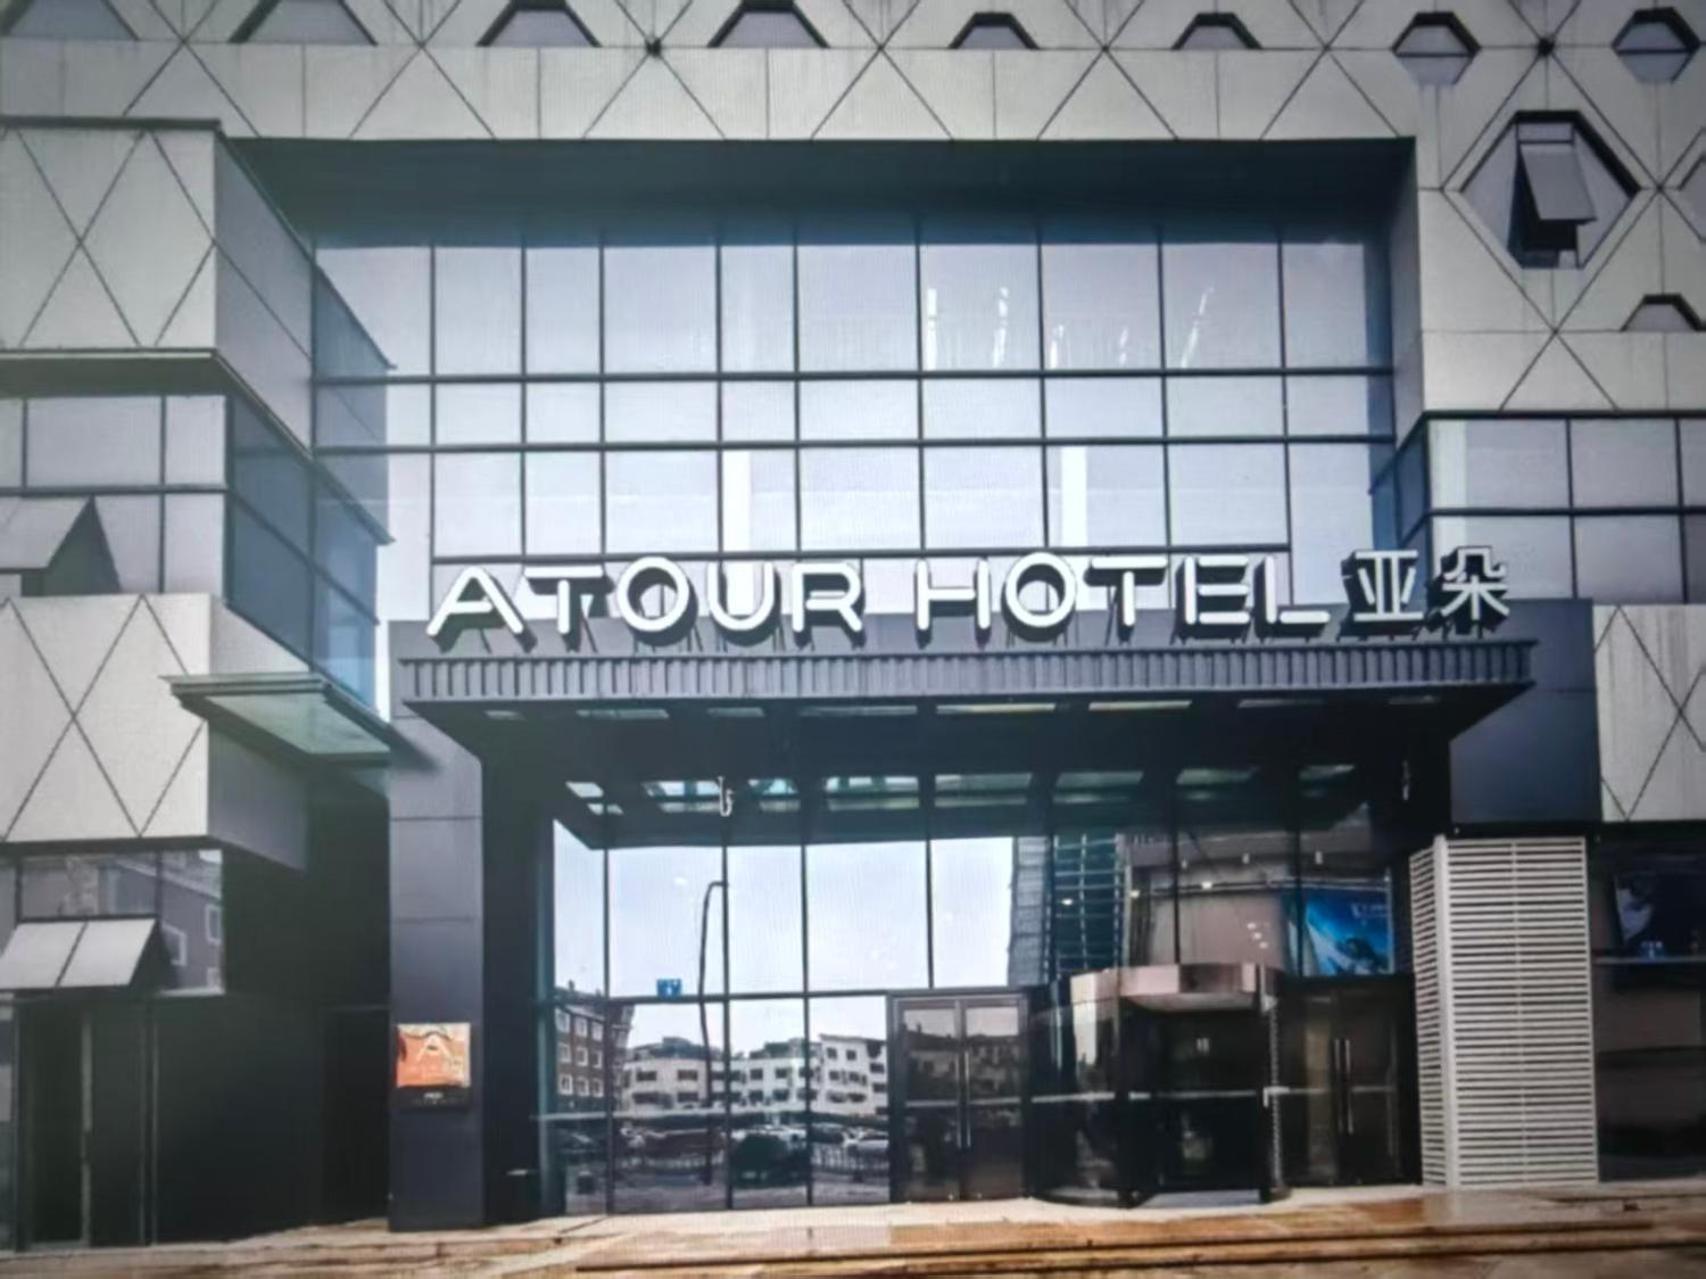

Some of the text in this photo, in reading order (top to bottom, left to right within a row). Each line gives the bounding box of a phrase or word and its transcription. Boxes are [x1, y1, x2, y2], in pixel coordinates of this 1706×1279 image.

[426, 546, 1511, 637] ATOUR HOTEL 亚朵
